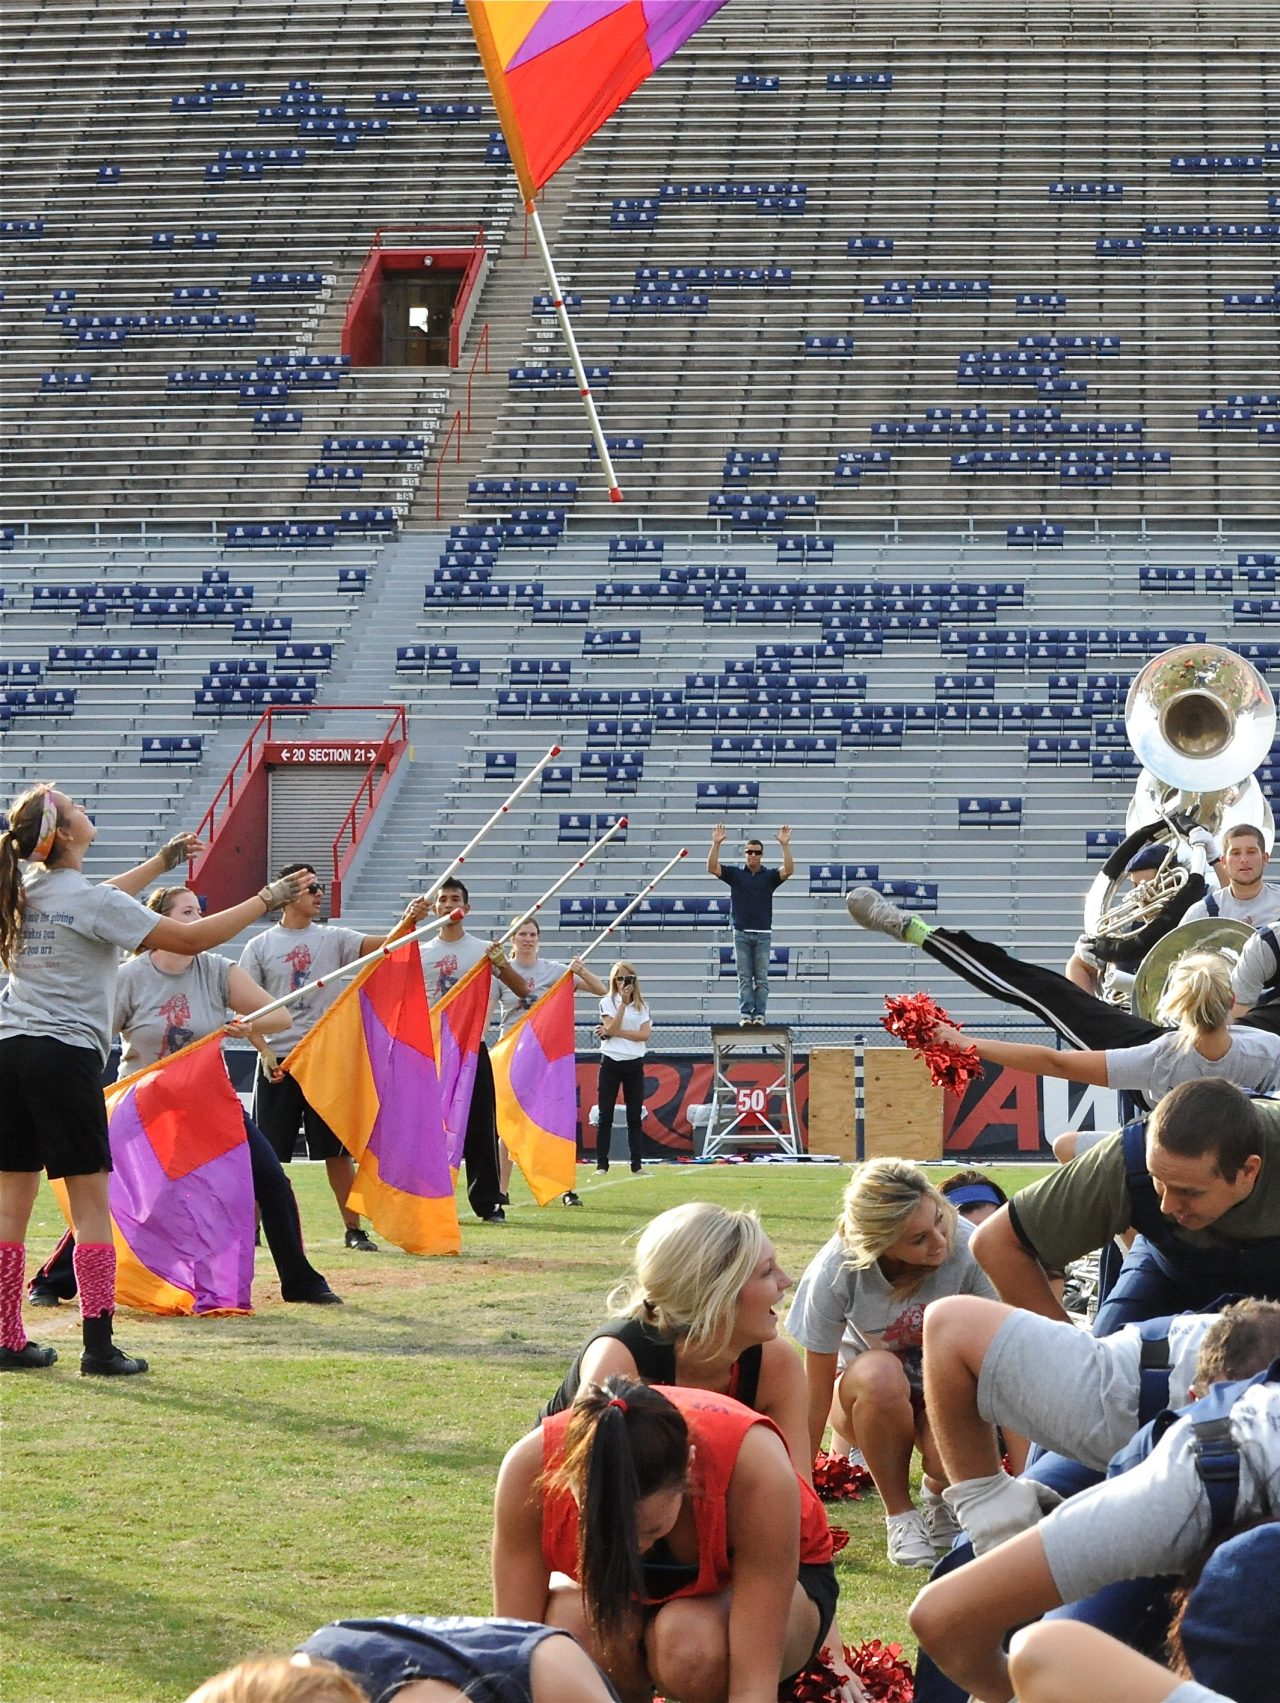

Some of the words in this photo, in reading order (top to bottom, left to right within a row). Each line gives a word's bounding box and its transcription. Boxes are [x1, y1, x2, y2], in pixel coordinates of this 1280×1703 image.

[293, 749, 305, 761] 20
[309, 749, 351, 761] SECTION
[355, 749, 365, 761] 21
[738, 1088, 765, 1112] 50
